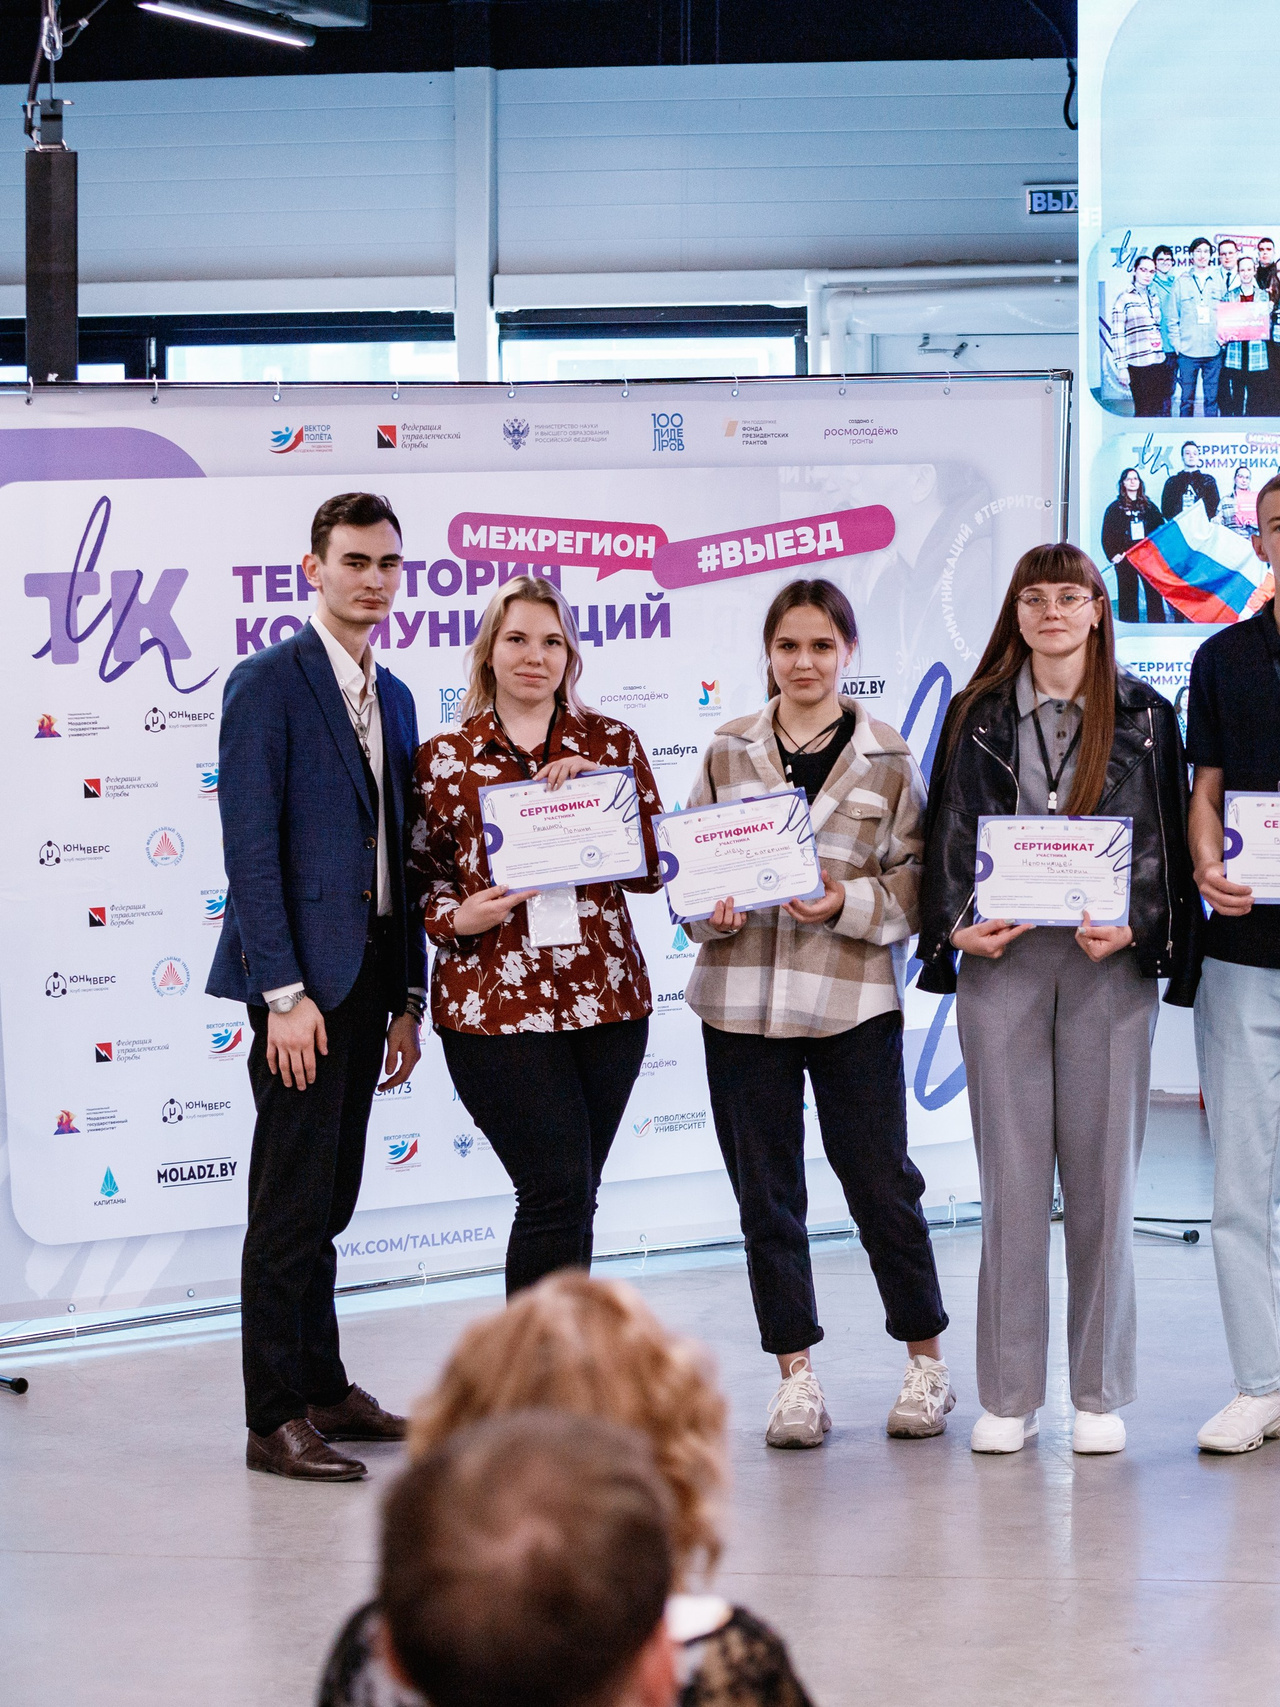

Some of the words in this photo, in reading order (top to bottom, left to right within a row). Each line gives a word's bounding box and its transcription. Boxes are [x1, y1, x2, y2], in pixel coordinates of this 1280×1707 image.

[651, 413, 683, 428] 100
[401, 423, 442, 432] Федерация
[304, 432, 332, 441] ПОЛЁТА
[401, 431, 461, 441] управленческой
[401, 441, 428, 450] борьбы
[1197, 445, 1279, 455] ЕРРИТОРИЯ
[462, 523, 656, 560] МЕЖРЕГИОН
[697, 520, 844, 573] #ВЫЕЗД
[842, 681, 885, 695] ADZ.BY
[652, 744, 698, 757] алабуга
[105, 782, 159, 791] управленческой
[105, 791, 129, 799] борьбы
[520, 799, 600, 818] СЕРТИФИКАТ
[544, 813, 575, 821] УЧАСТНИКА
[695, 821, 775, 844] СЕРТИФИКАТ
[719, 837, 750, 846] УЧАСТНИКА
[1014, 843, 1094, 851] СЕРТИФИКАТ
[110, 910, 163, 919] управленческой
[110, 919, 134, 927] борьбы
[657, 990, 686, 1003] алаб
[116, 1038, 152, 1047] Федерация
[116, 1054, 141, 1063] борьбы
[654, 1110, 706, 1123] ПОВОЛЖСКИЙ
[654, 1121, 706, 1133] УНИВЕРСИТЕТ
[157, 1162, 237, 1184] MOLADZ.BY
[338, 1227, 495, 1257] VK.COM/TALKAREA
